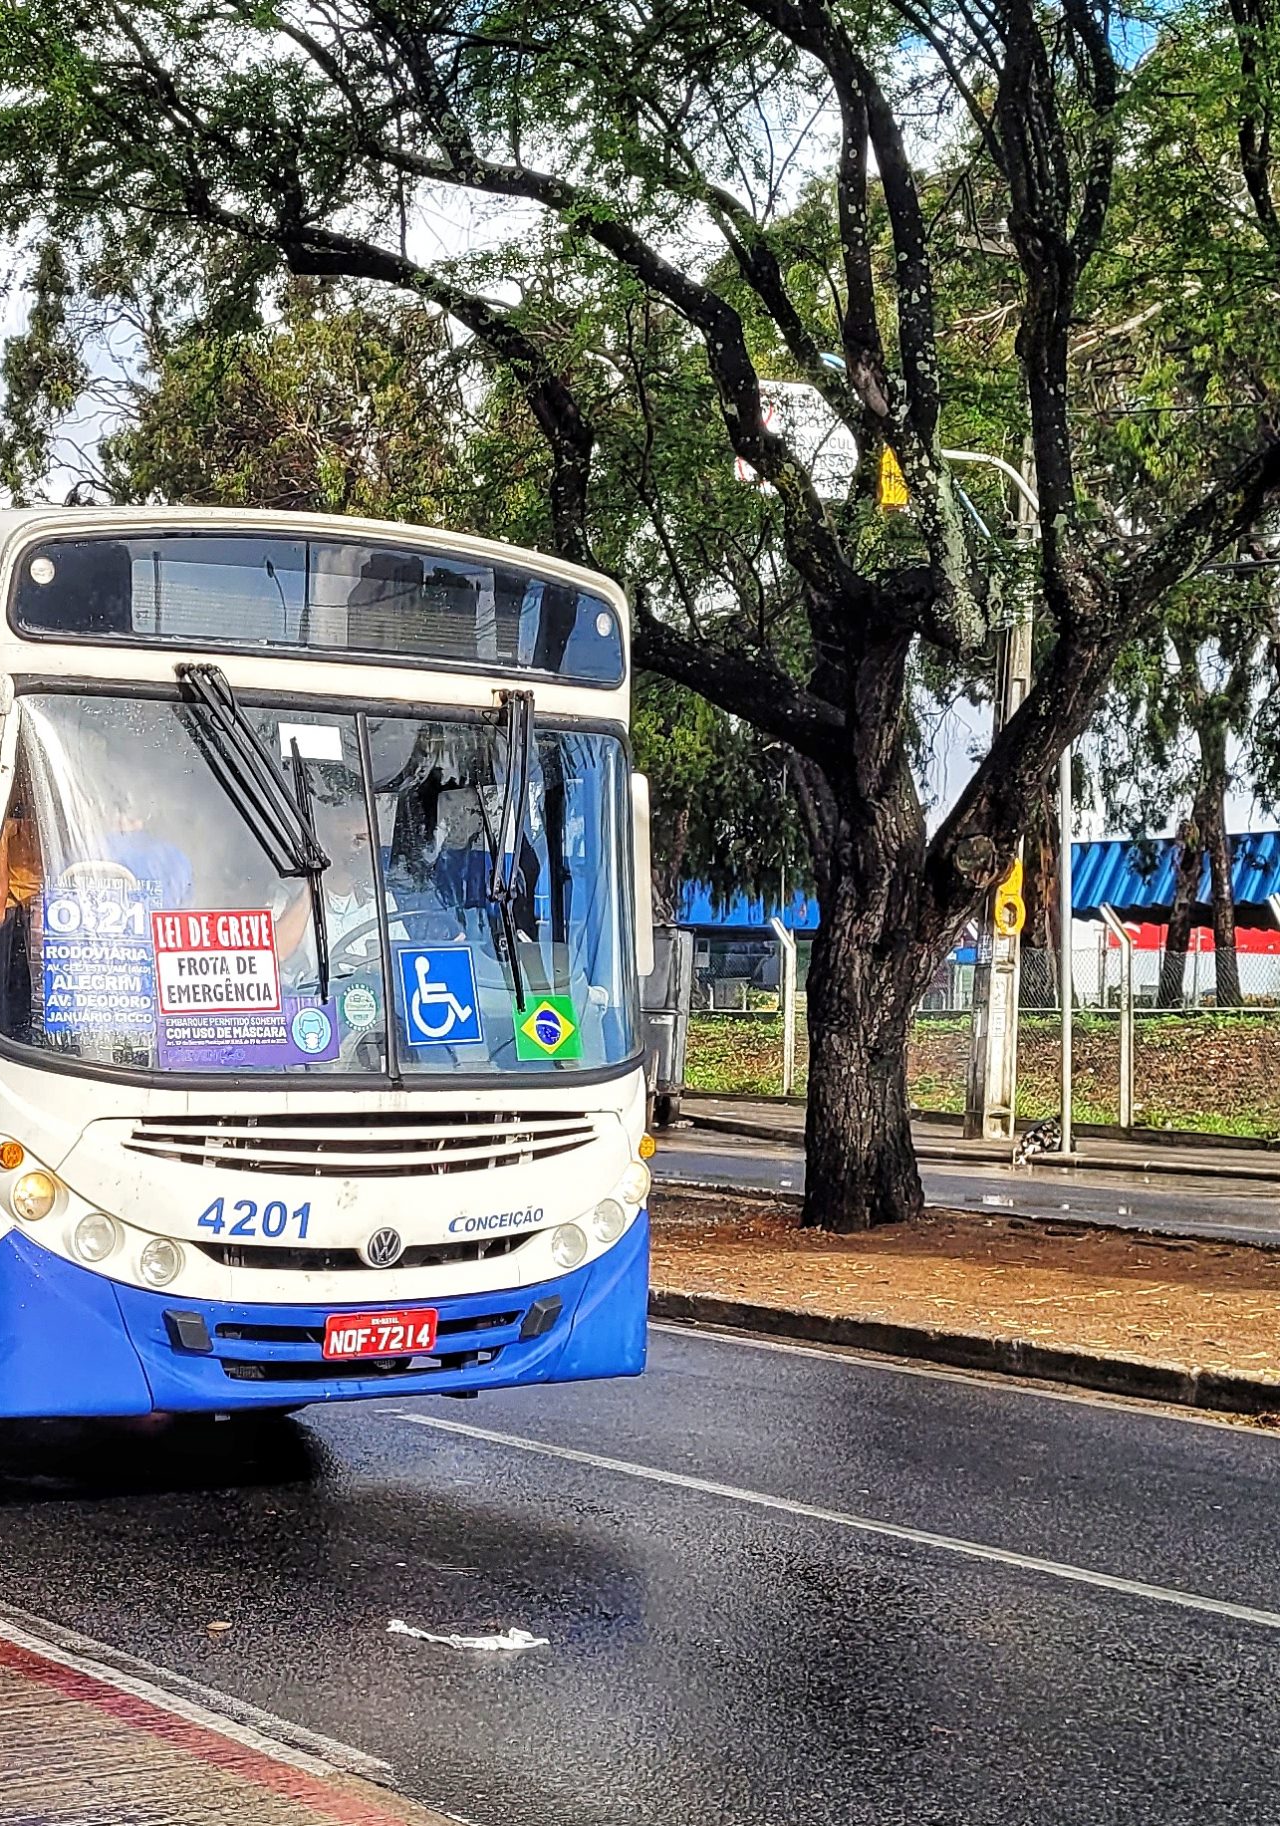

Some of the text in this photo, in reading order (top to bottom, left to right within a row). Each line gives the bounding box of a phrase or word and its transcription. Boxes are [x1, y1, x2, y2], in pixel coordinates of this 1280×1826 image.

[156, 913, 271, 949] LEI DE GREVE
[177, 955, 258, 977] FROTA DE
[75, 994, 152, 1009] DEODORO
[166, 977, 273, 1004] EMERGÊNCIA
[166, 1016, 287, 1027] EMBARQUE PERMITIDO SOMENTE
[166, 1024, 288, 1040] COM USO DE MÁSCARA
[197, 1197, 312, 1240] 4201
[448, 1205, 544, 1233] CONCEIÇÃO
